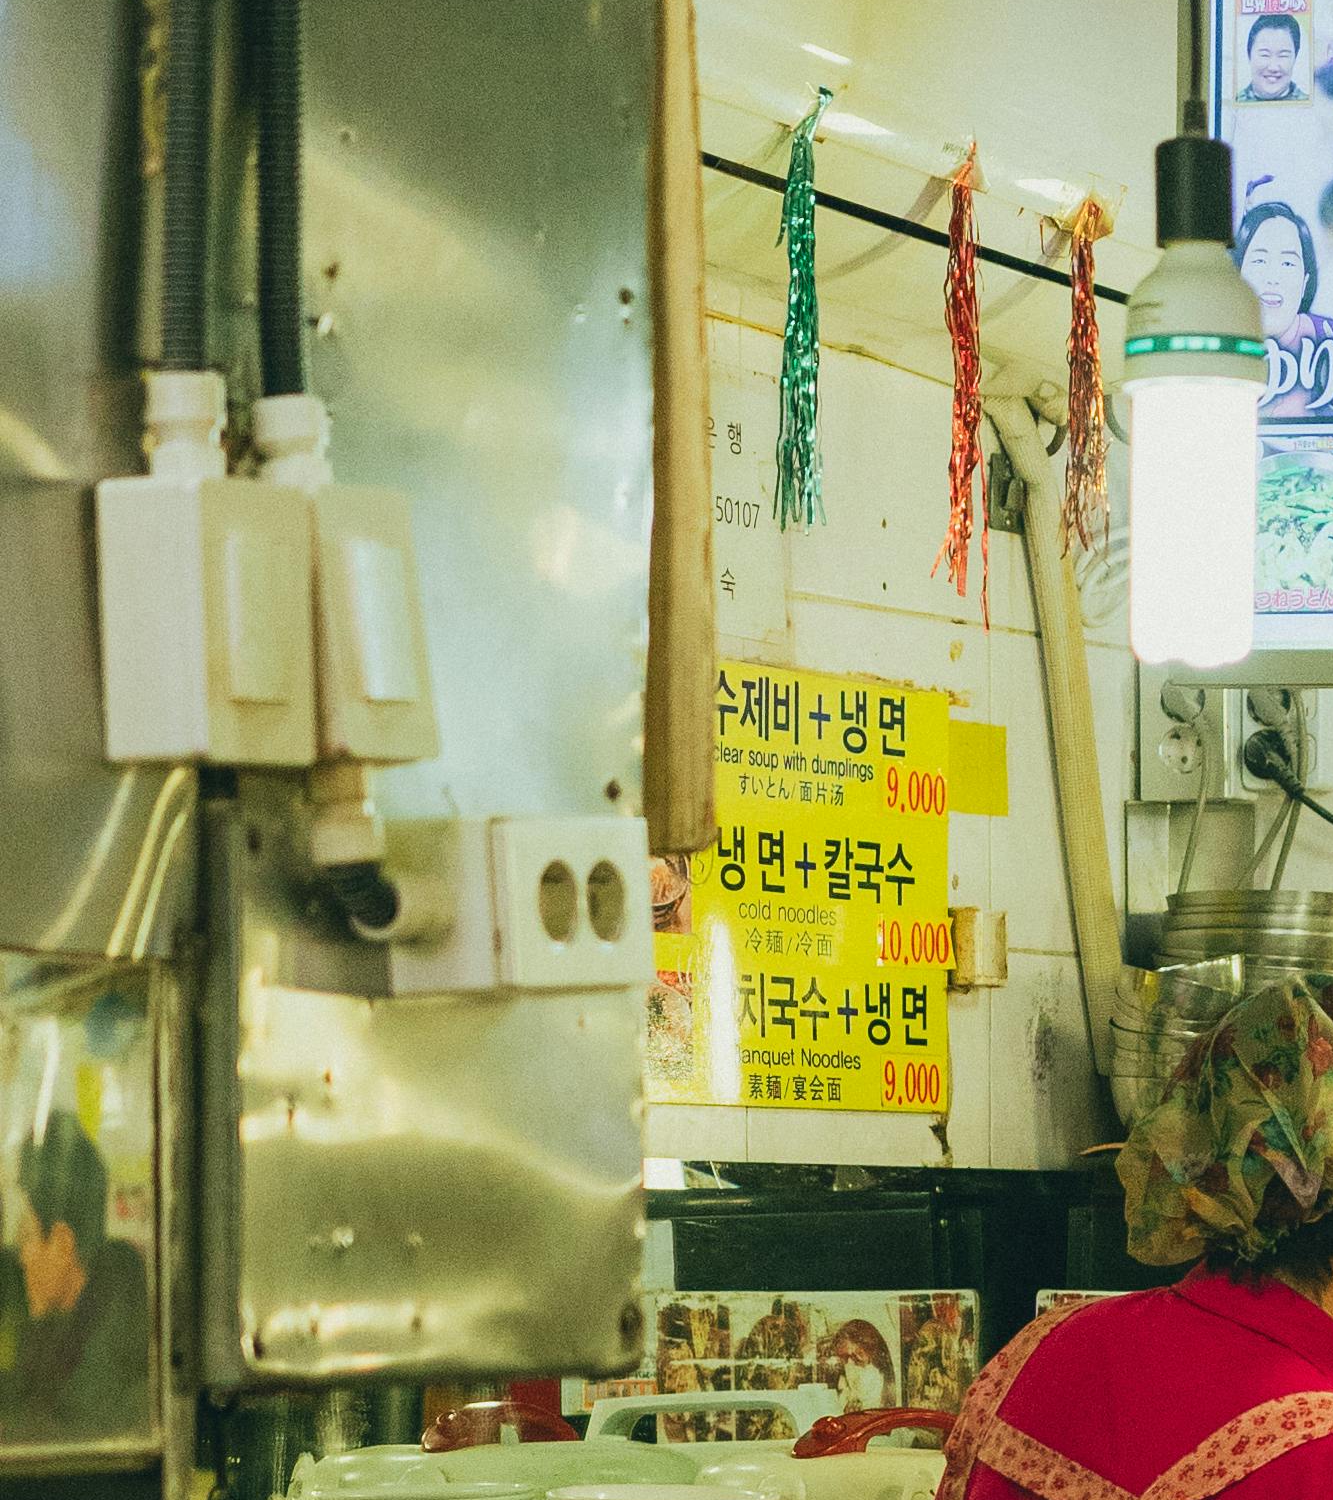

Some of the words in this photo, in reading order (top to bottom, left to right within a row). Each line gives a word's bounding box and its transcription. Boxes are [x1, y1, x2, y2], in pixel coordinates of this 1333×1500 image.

[748, 749, 779, 771] soup
[783, 750, 808, 773] with
[812, 752, 874, 783] dumplings
[824, 836, 916, 906] 칼국수
[738, 900, 774, 922] cold
[778, 903, 837, 926] noodles
[739, 1047, 795, 1069] anquet
[800, 1047, 861, 1071] Noodles
